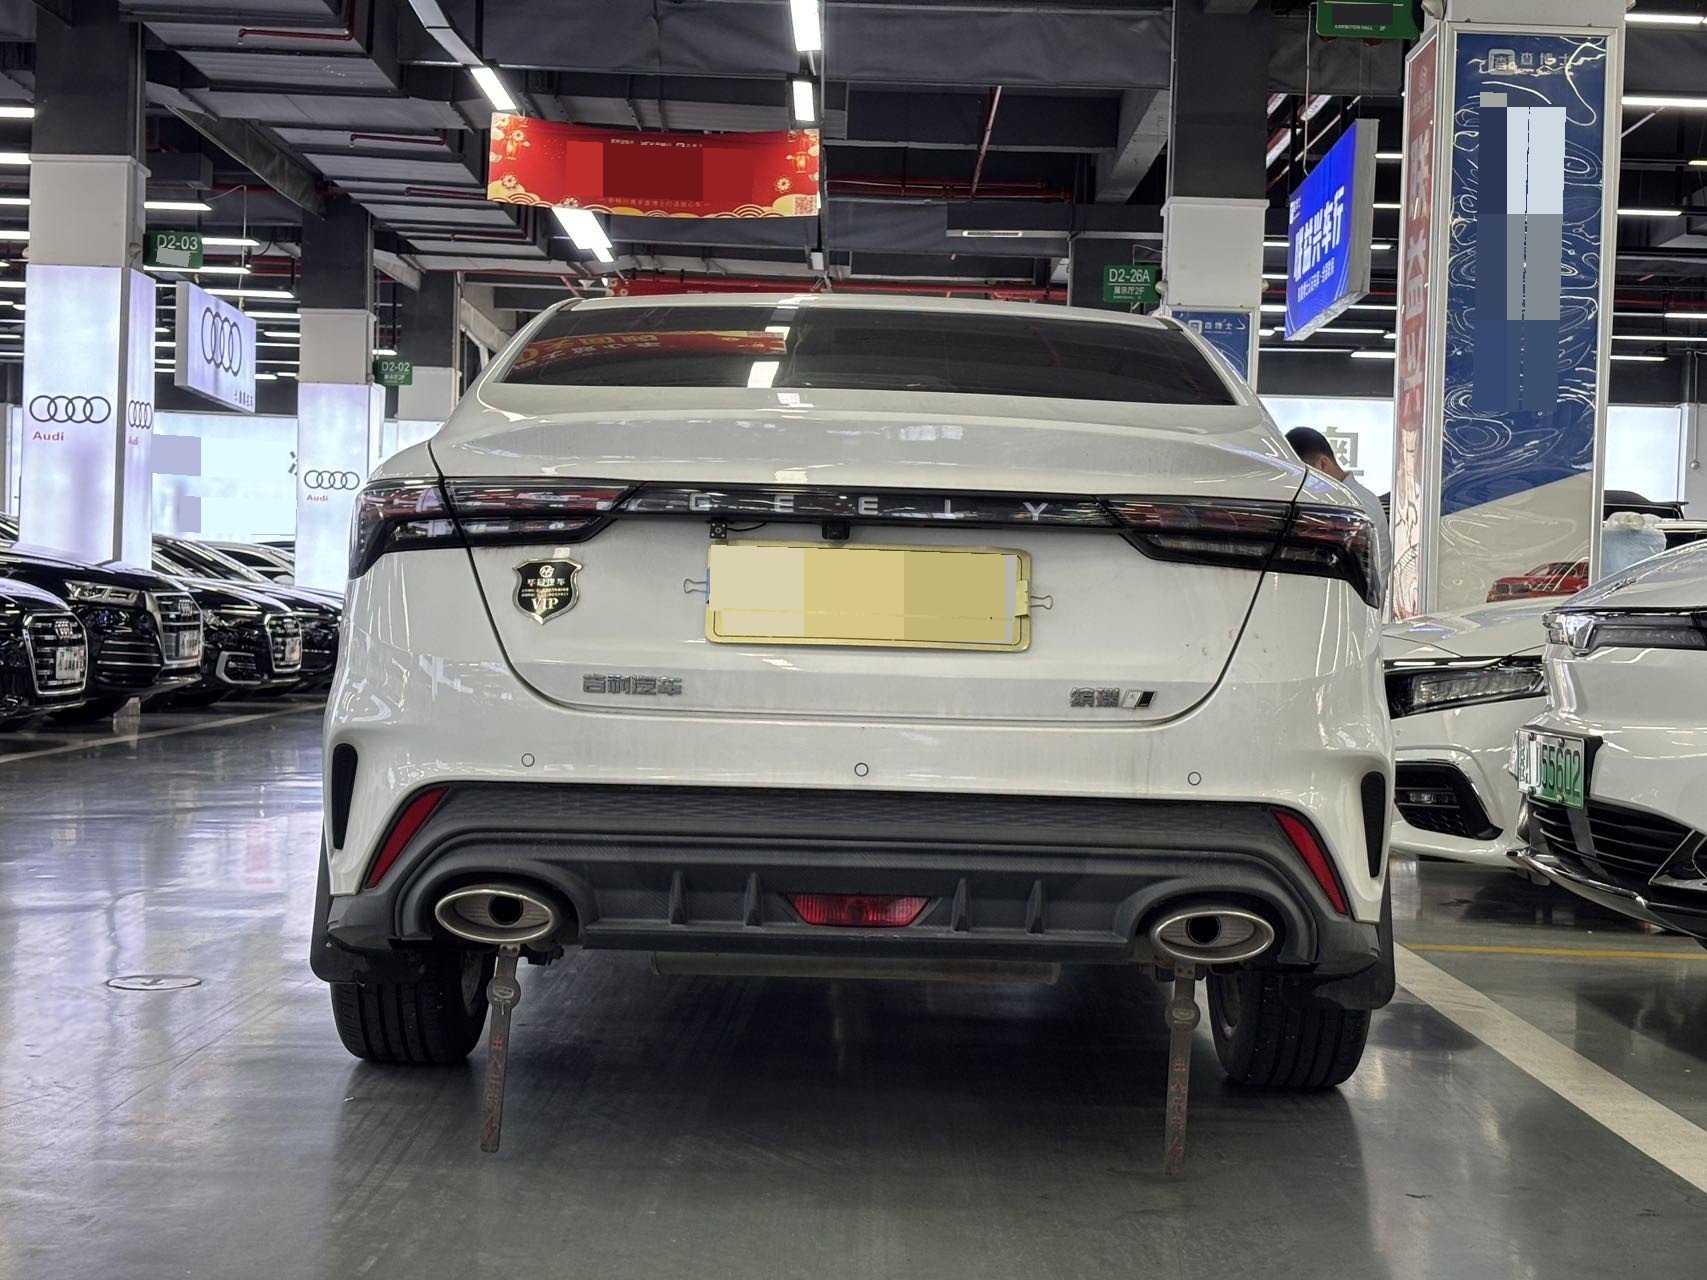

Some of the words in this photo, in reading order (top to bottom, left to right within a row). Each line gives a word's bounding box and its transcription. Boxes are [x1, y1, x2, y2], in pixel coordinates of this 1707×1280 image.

[157, 234, 198, 250] D2-03
[1109, 268, 1151, 283] D2-26A
[381, 361, 410, 371] D2-02
[32, 431, 64, 441] Audi
[306, 494, 329, 502] Audi
[531, 597, 559, 610] VIP
[582, 673, 683, 696] 吉利汽车
